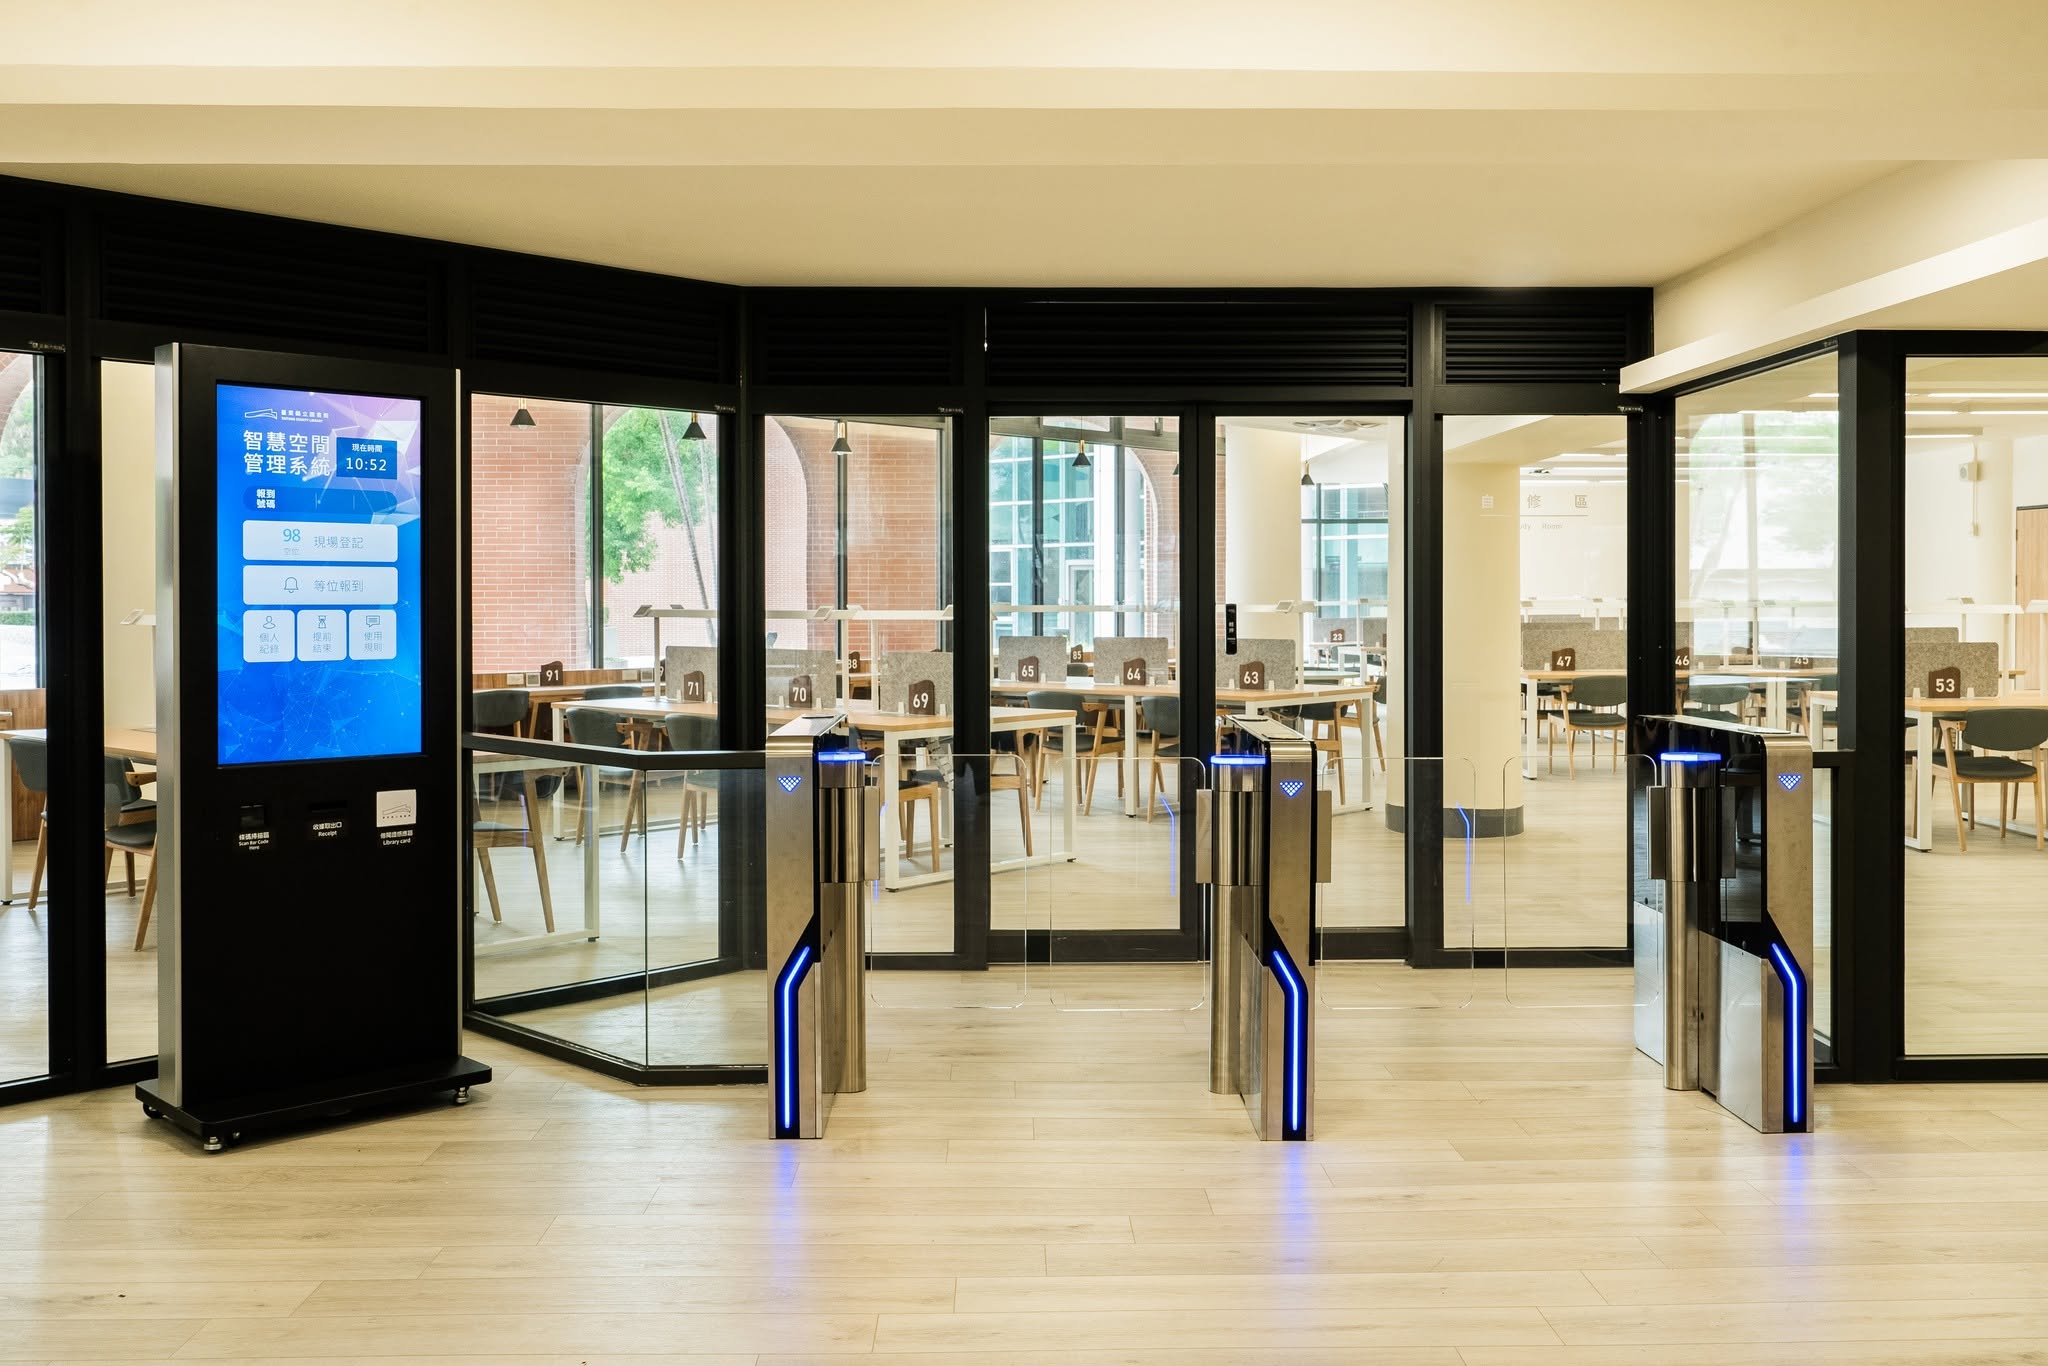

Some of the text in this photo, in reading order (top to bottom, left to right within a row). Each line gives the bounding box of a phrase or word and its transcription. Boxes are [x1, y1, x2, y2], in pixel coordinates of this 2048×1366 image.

[243, 430, 330, 455] 智慧空間
[351, 443, 383, 453] 現在時間
[243, 453, 330, 477] 管理系統
[346, 457, 387, 472] 10:52
[256, 488, 276, 499] 報到
[256, 499, 276, 509] 號碼
[1481, 494, 1588, 509] 自修區
[283, 528, 301, 543] 98
[314, 536, 364, 549] 現場登記
[314, 579, 364, 593] 等位報到
[259, 632, 279, 643] 個人
[313, 632, 332, 642] 提前
[364, 631, 383, 641] 使用
[1332, 633, 1343, 641] 23
[364, 642, 383, 652] 規則
[1072, 650, 1082, 660] 85
[1556, 655, 1572, 667] 47
[1675, 655, 1690, 667] 46
[1794, 656, 1809, 665] 45
[545, 669, 559, 681] 91
[1021, 665, 1035, 679] 65
[1127, 667, 1141, 681] 64
[1243, 671, 1259, 685] 63
[687, 681, 700, 696] 71
[1935, 678, 1955, 693] 53
[793, 687, 807, 702] 70
[913, 693, 929, 708] 69
[382, 838, 400, 846] Library
